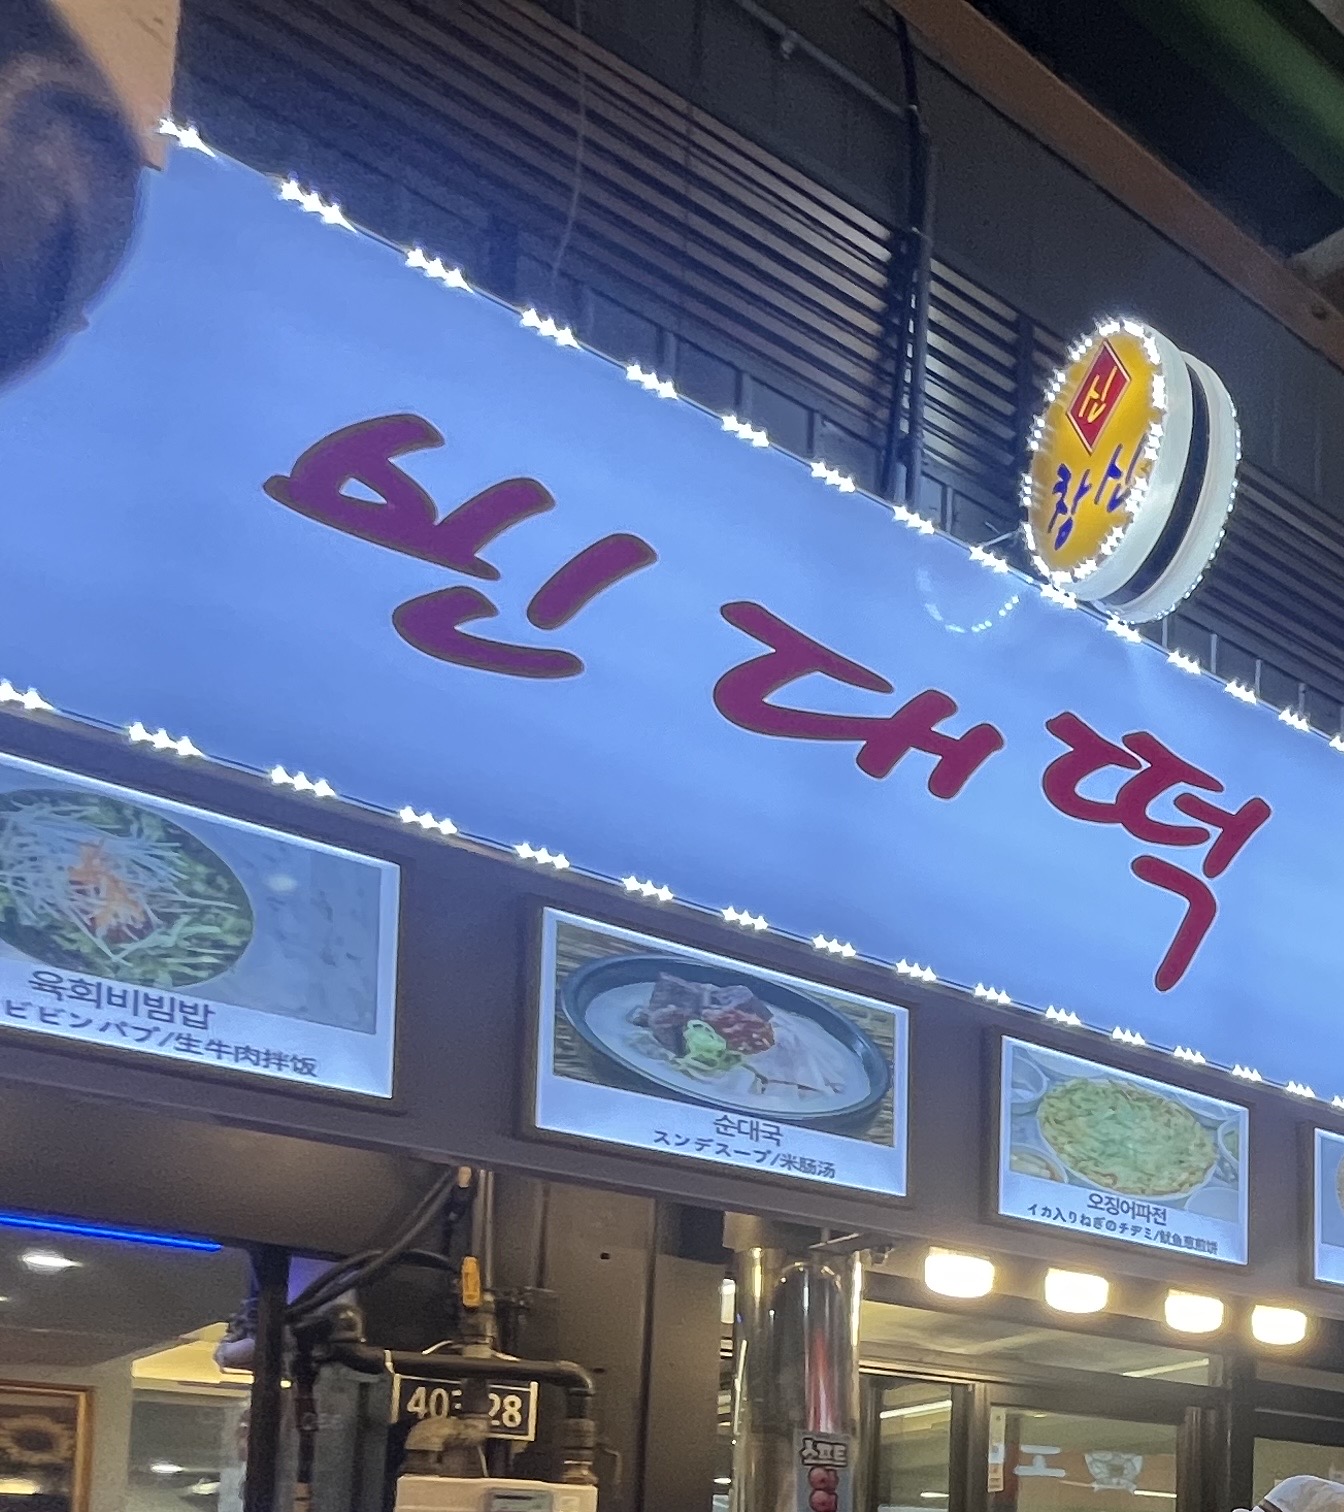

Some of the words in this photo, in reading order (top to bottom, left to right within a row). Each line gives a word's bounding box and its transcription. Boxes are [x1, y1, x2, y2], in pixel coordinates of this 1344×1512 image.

[1078, 366, 1118, 423] 신
[1048, 432, 1149, 550] 창신
[263, 413, 1271, 992] 빈대떡
[28, 970, 215, 1030] 육회비빔밥
[713, 1115, 783, 1147] 순대국
[1087, 1193, 1167, 1226] 오징어파전
